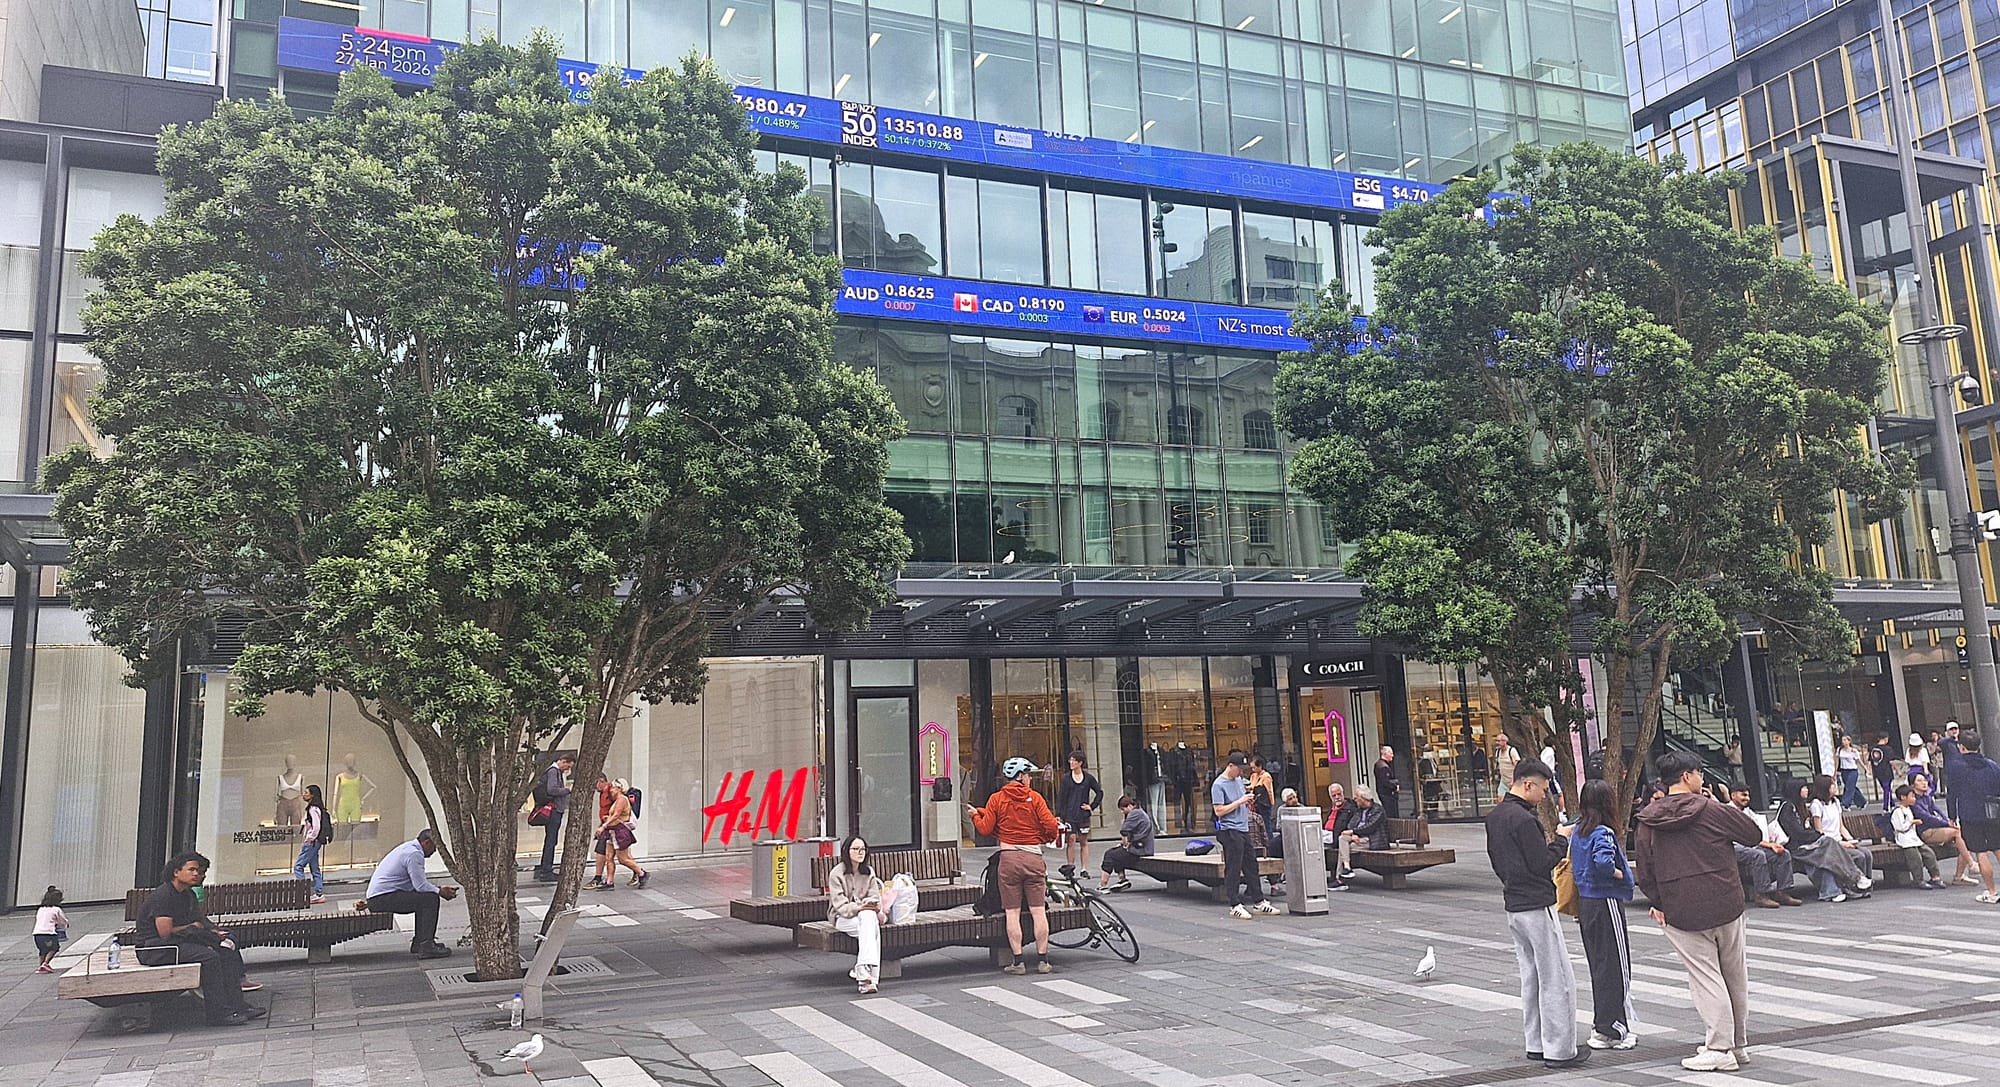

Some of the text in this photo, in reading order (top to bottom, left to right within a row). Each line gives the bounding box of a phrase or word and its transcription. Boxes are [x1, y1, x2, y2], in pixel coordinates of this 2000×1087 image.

[340, 33, 426, 63] 5:24pm
[335, 51, 354, 65] 27
[393, 61, 431, 76] 2026
[763, 116, 800, 130] 0.489%
[842, 111, 877, 137] 50
[884, 117, 963, 140] 13510.88
[842, 134, 878, 148] INDEX
[884, 134, 910, 146] 50.14
[918, 138, 952, 151] 0.372%
[1354, 177, 1381, 193] ESG
[1391, 185, 1428, 203] $4.70
[844, 283, 935, 301] AUD 0.8625
[885, 300, 916, 311] 0.0007
[982, 296, 1065, 313] CAD 0.8190
[1019, 312, 1048, 323] 0.0003
[1110, 307, 1186, 324] EUR 0.5024
[1218, 318, 1247, 333] NZ's
[1250, 323, 1284, 337] most
[1319, 660, 1365, 675] COACH
[702, 766, 808, 846] H&M
[233, 836, 258, 844] FROM
[776, 856, 787, 897] ecycling
